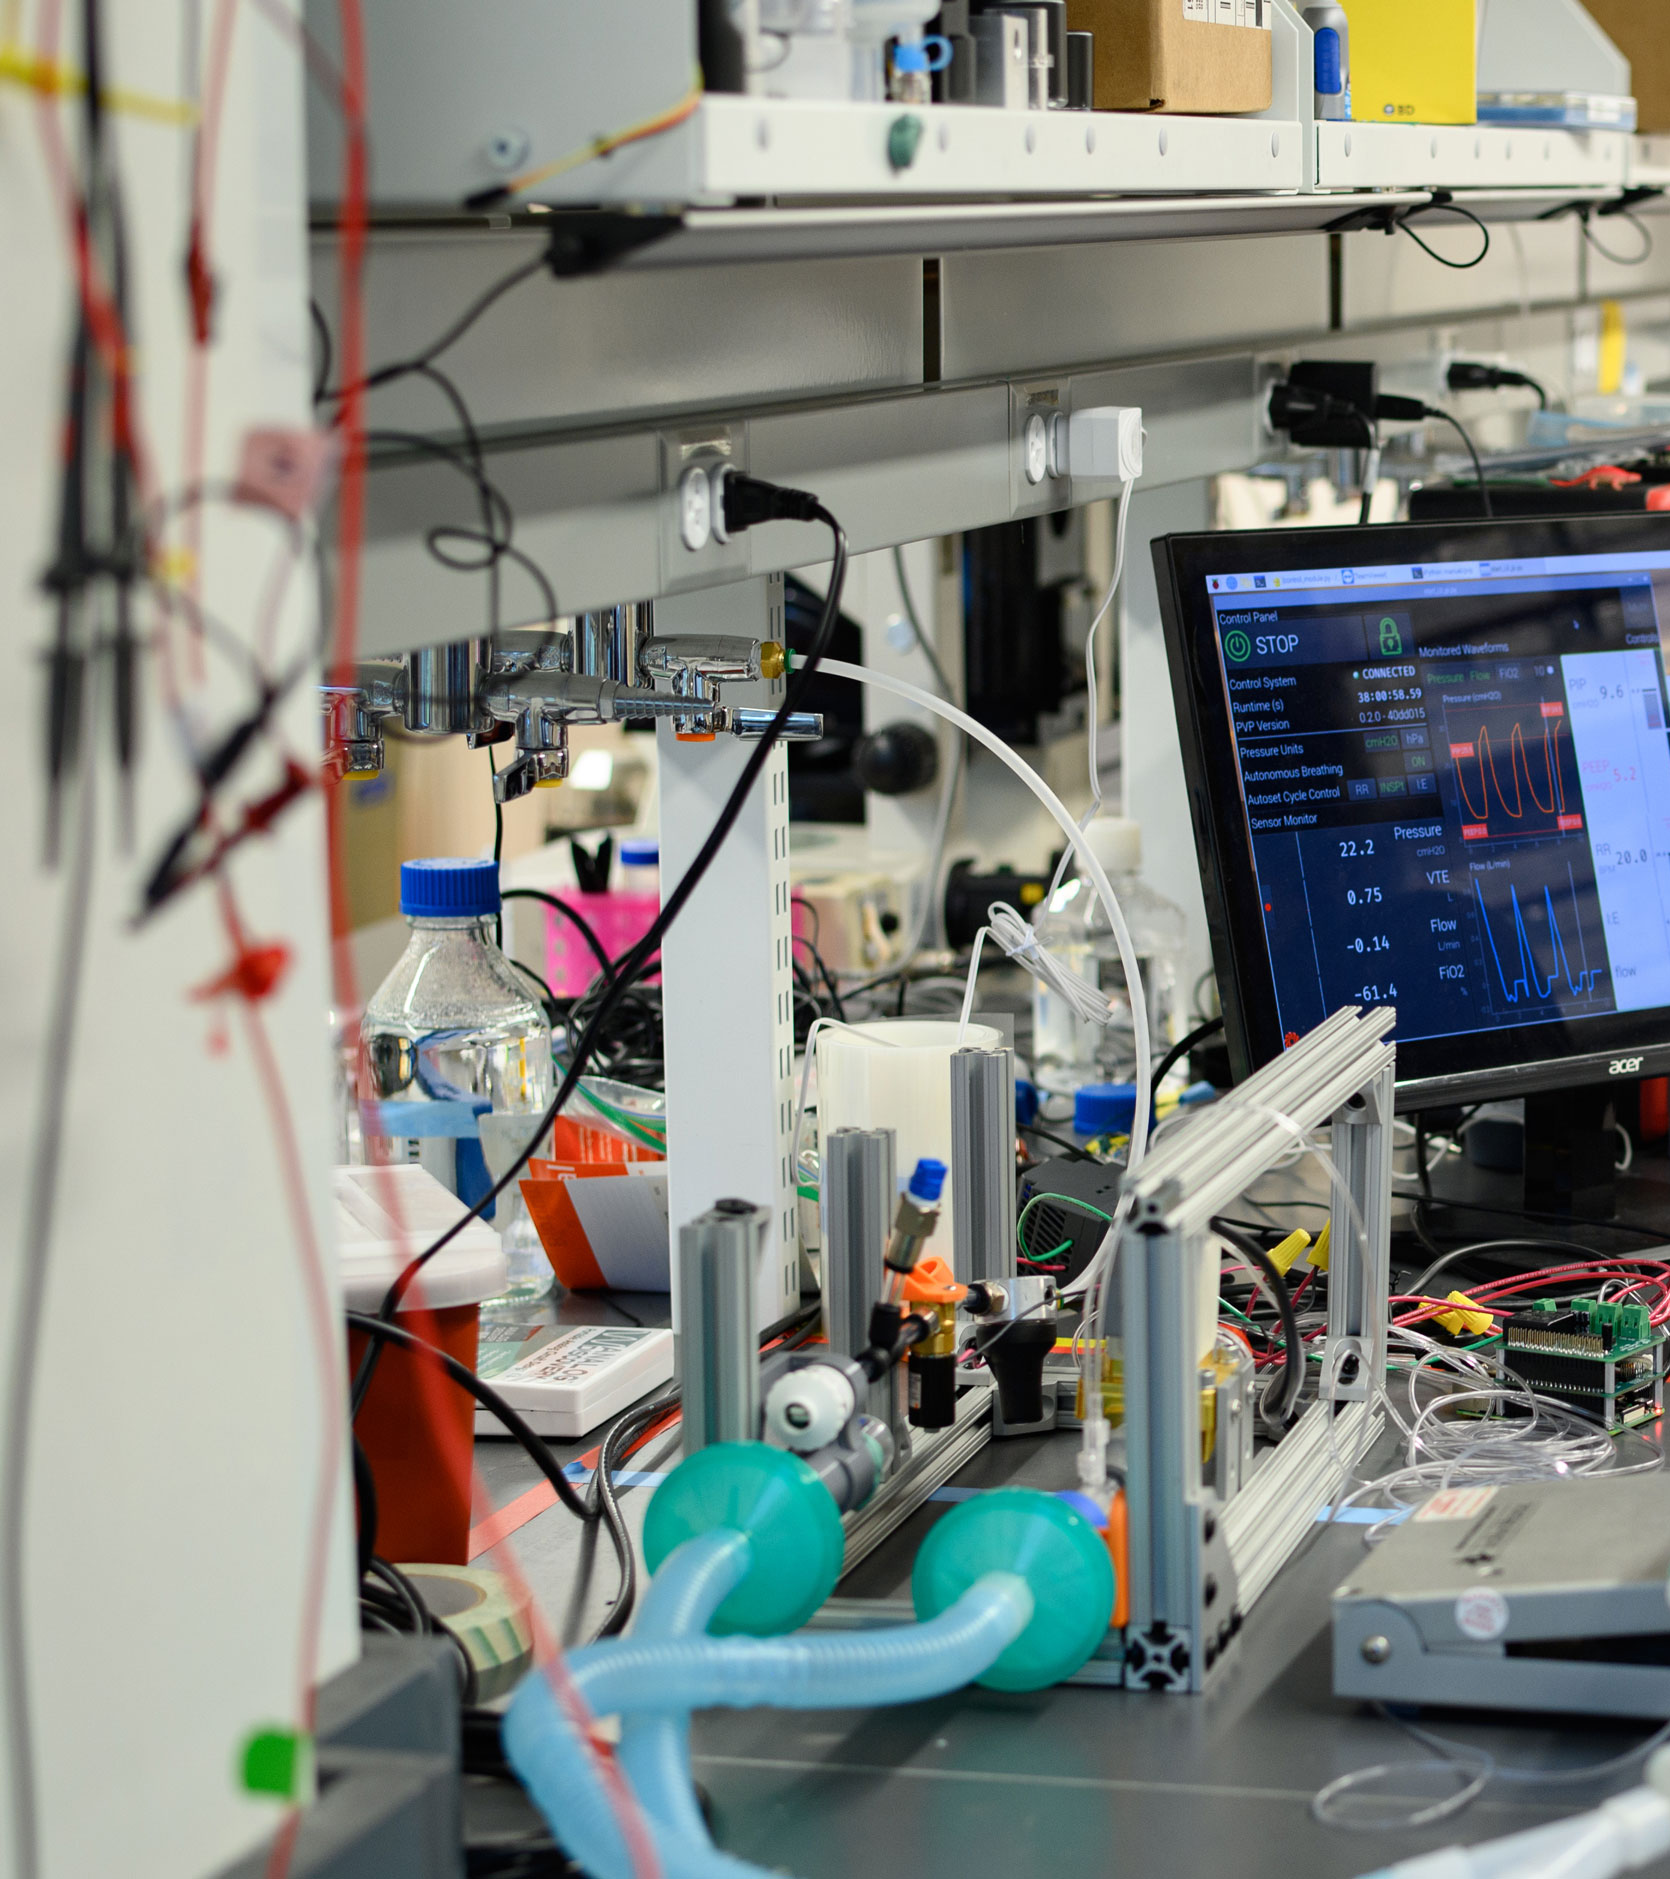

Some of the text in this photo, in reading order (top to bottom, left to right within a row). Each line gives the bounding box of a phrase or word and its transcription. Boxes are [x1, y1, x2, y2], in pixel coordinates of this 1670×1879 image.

[1219, 610, 1278, 625] Control Panel
[1256, 634, 1299, 655] STOP
[1419, 643, 1510, 658] Monitored Waveforms
[1362, 666, 1416, 679] CONNECTED
[1427, 673, 1465, 684] Pressure
[1470, 670, 1491, 681] Flow
[1499, 667, 1519, 679] FiO2
[1229, 675, 1297, 691] Control System
[1357, 687, 1422, 704] 38:00:58.59
[1599, 683, 1624, 700] 9.6
[1233, 699, 1284, 714] Runtime (s)
[1236, 718, 1290, 733] PVP Version
[1406, 732, 1425, 745] hPa
[1240, 743, 1304, 758] Pressure Units
[1411, 755, 1426, 767] ON
[1244, 763, 1344, 782] Autonomous Breathing
[1612, 765, 1637, 782] 5.2
[1248, 786, 1340, 806] Autoset Cycle Control
[1355, 783, 1369, 795] RR
[1251, 812, 1318, 830] Sensor Monitor
[1394, 824, 1443, 840] Pressure
[1339, 839, 1375, 857] 22.2
[1416, 845, 1446, 857] cmH2O
[1616, 848, 1648, 865] 20.0
[1469, 861, 1486, 871] Flow
[1426, 869, 1450, 885] VTE
[1347, 886, 1382, 905] 0.75
[1430, 918, 1457, 933] Flow
[1346, 935, 1390, 953] -0.14
[1437, 940, 1461, 951] L/min
[1438, 964, 1465, 980] FiO2
[1354, 982, 1398, 1001] -61.4
[1608, 1056, 1644, 1075] acer
